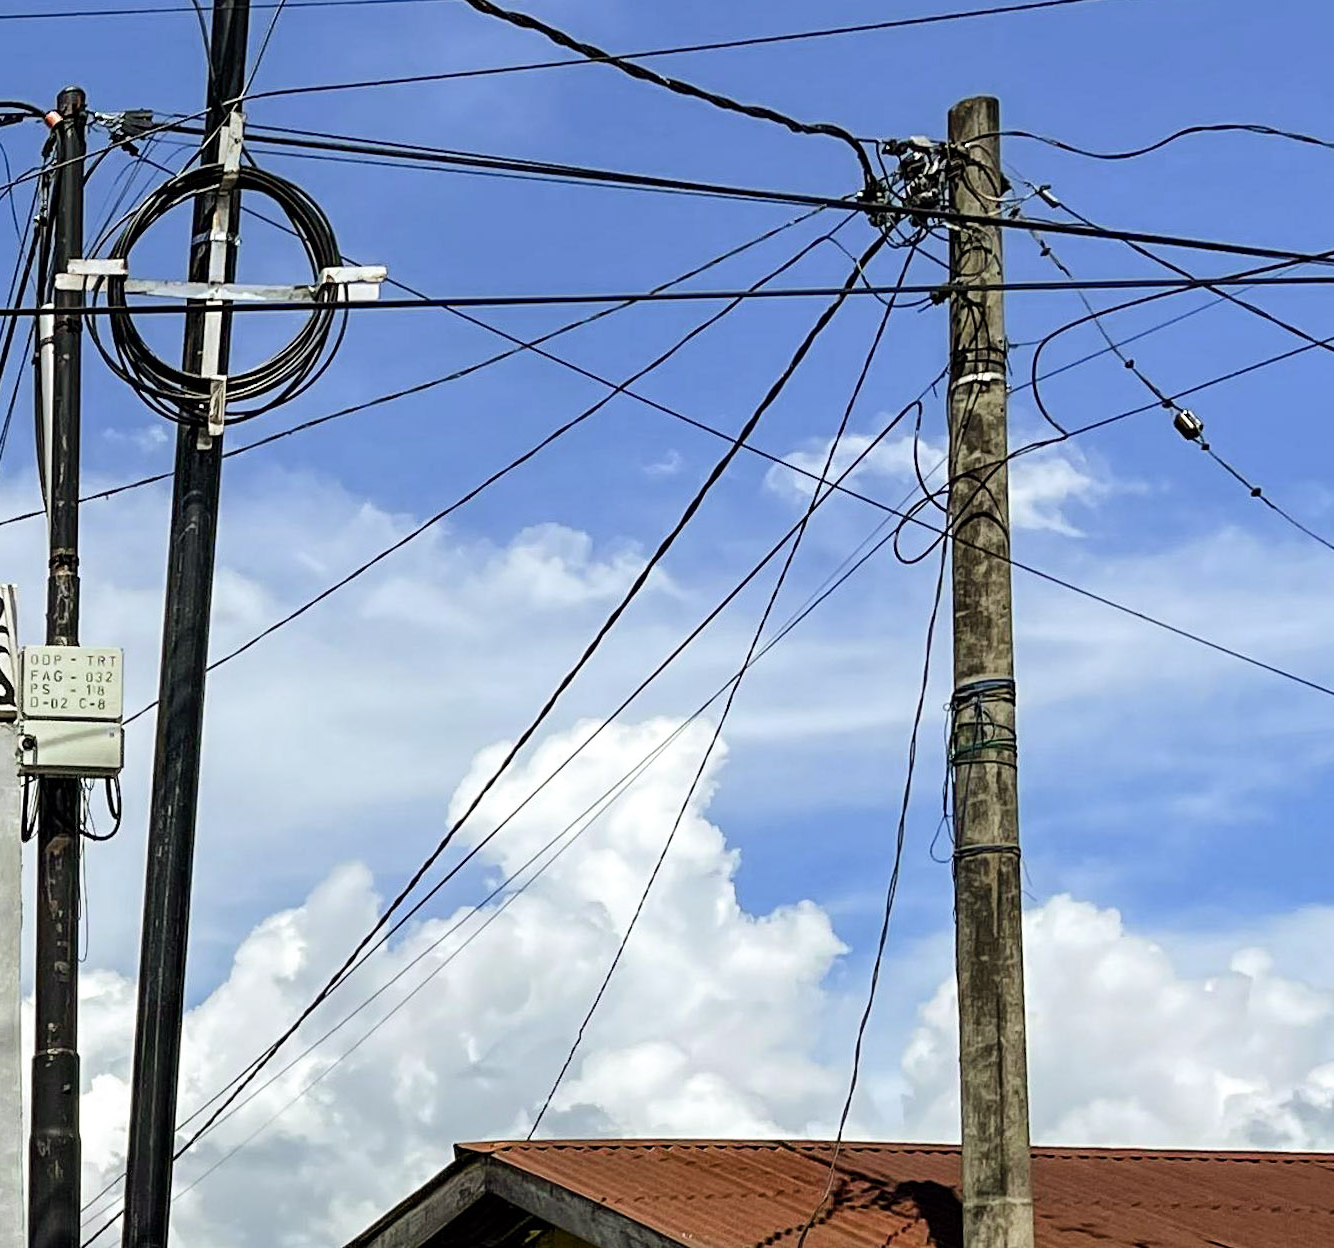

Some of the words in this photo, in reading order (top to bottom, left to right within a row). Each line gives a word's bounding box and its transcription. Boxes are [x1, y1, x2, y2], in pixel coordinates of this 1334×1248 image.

[87, 655, 117, 668] TRT
[30, 670, 64, 682] FAG
[30, 683, 51, 695] PS
[78, 698, 106, 710] C-8
